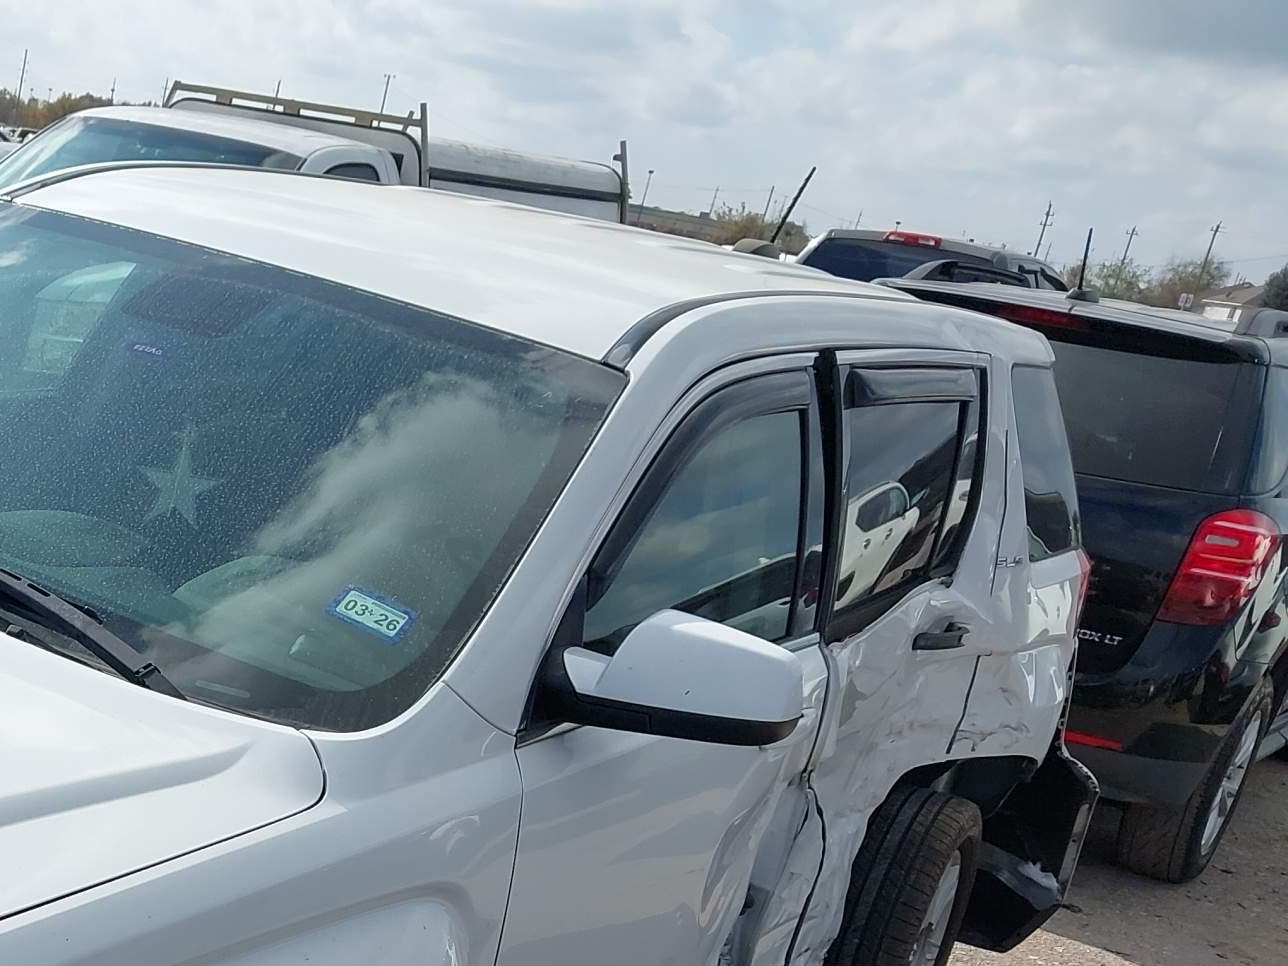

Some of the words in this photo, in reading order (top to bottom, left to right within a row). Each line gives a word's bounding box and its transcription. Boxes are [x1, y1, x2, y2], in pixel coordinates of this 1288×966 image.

[343, 599, 369, 617] 03
[373, 613, 401, 632] 26
[1104, 634, 1123, 645] LT
